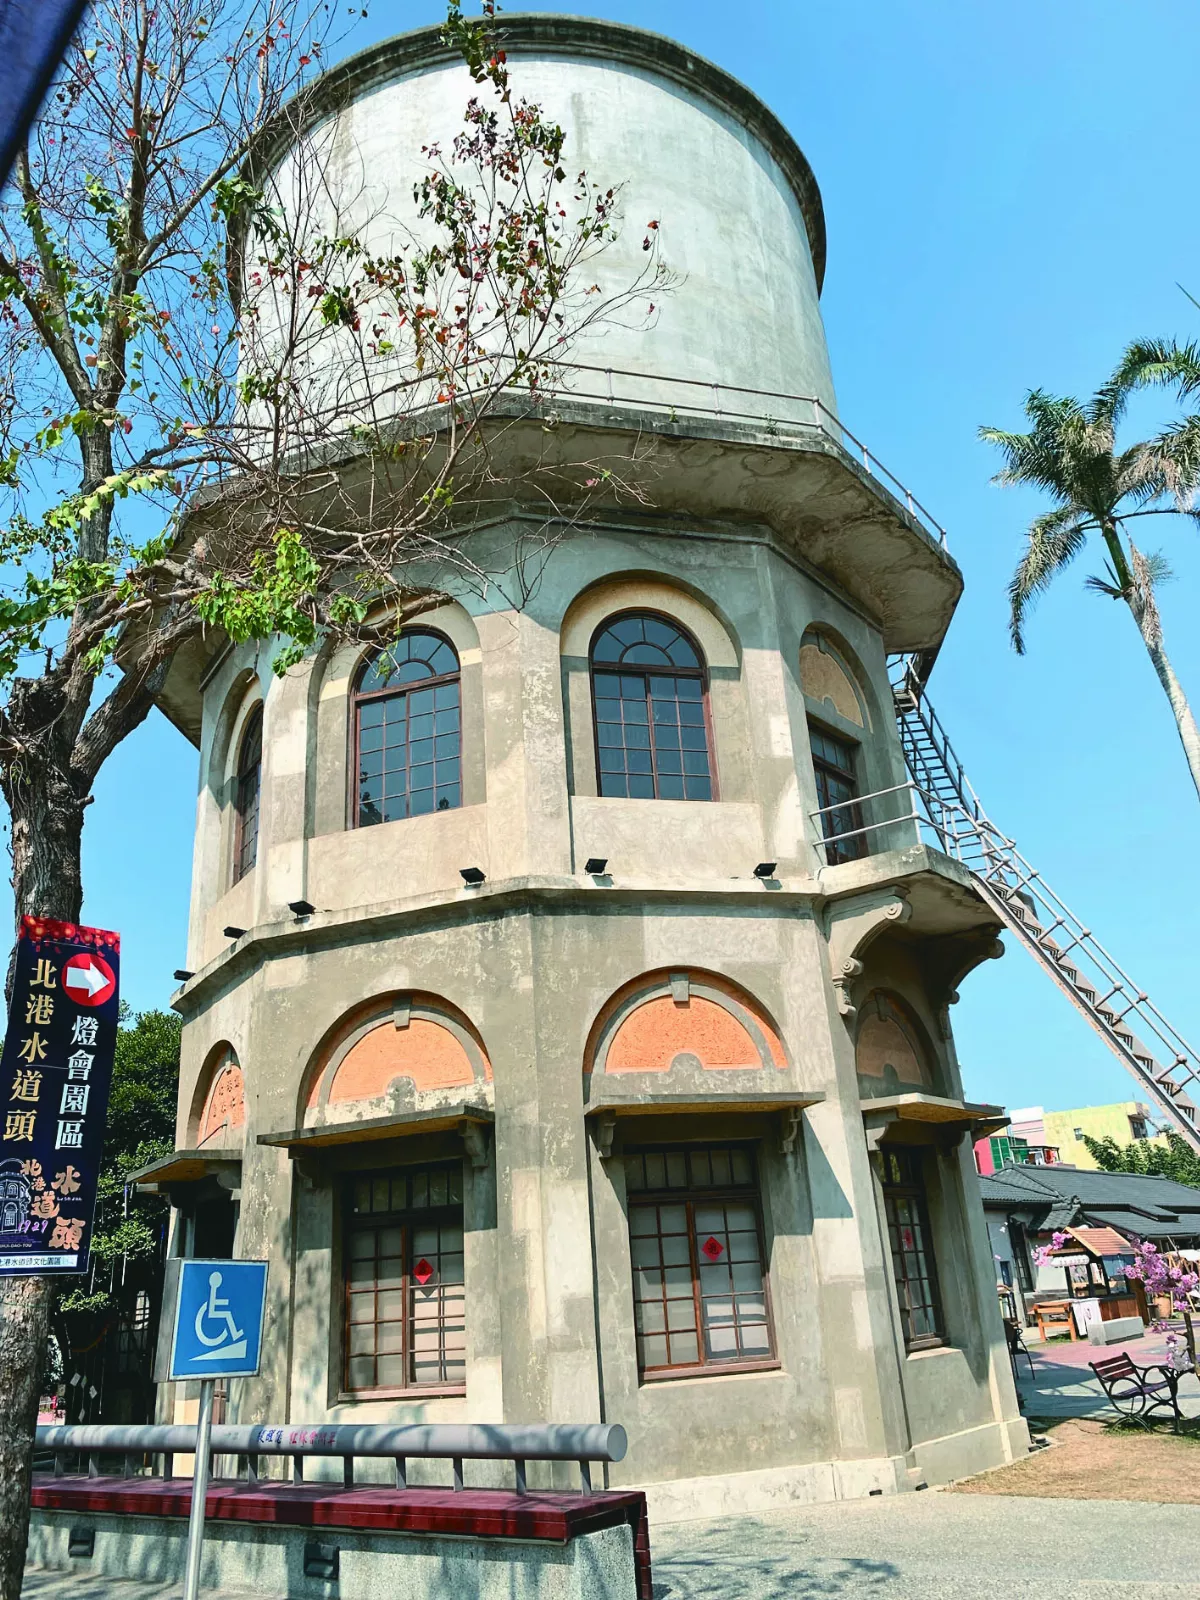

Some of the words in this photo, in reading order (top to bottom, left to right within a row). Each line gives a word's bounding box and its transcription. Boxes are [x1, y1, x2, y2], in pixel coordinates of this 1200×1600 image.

[3, 958, 57, 1142] 北港水道頭
[55, 1014, 99, 1150] 燈會園區
